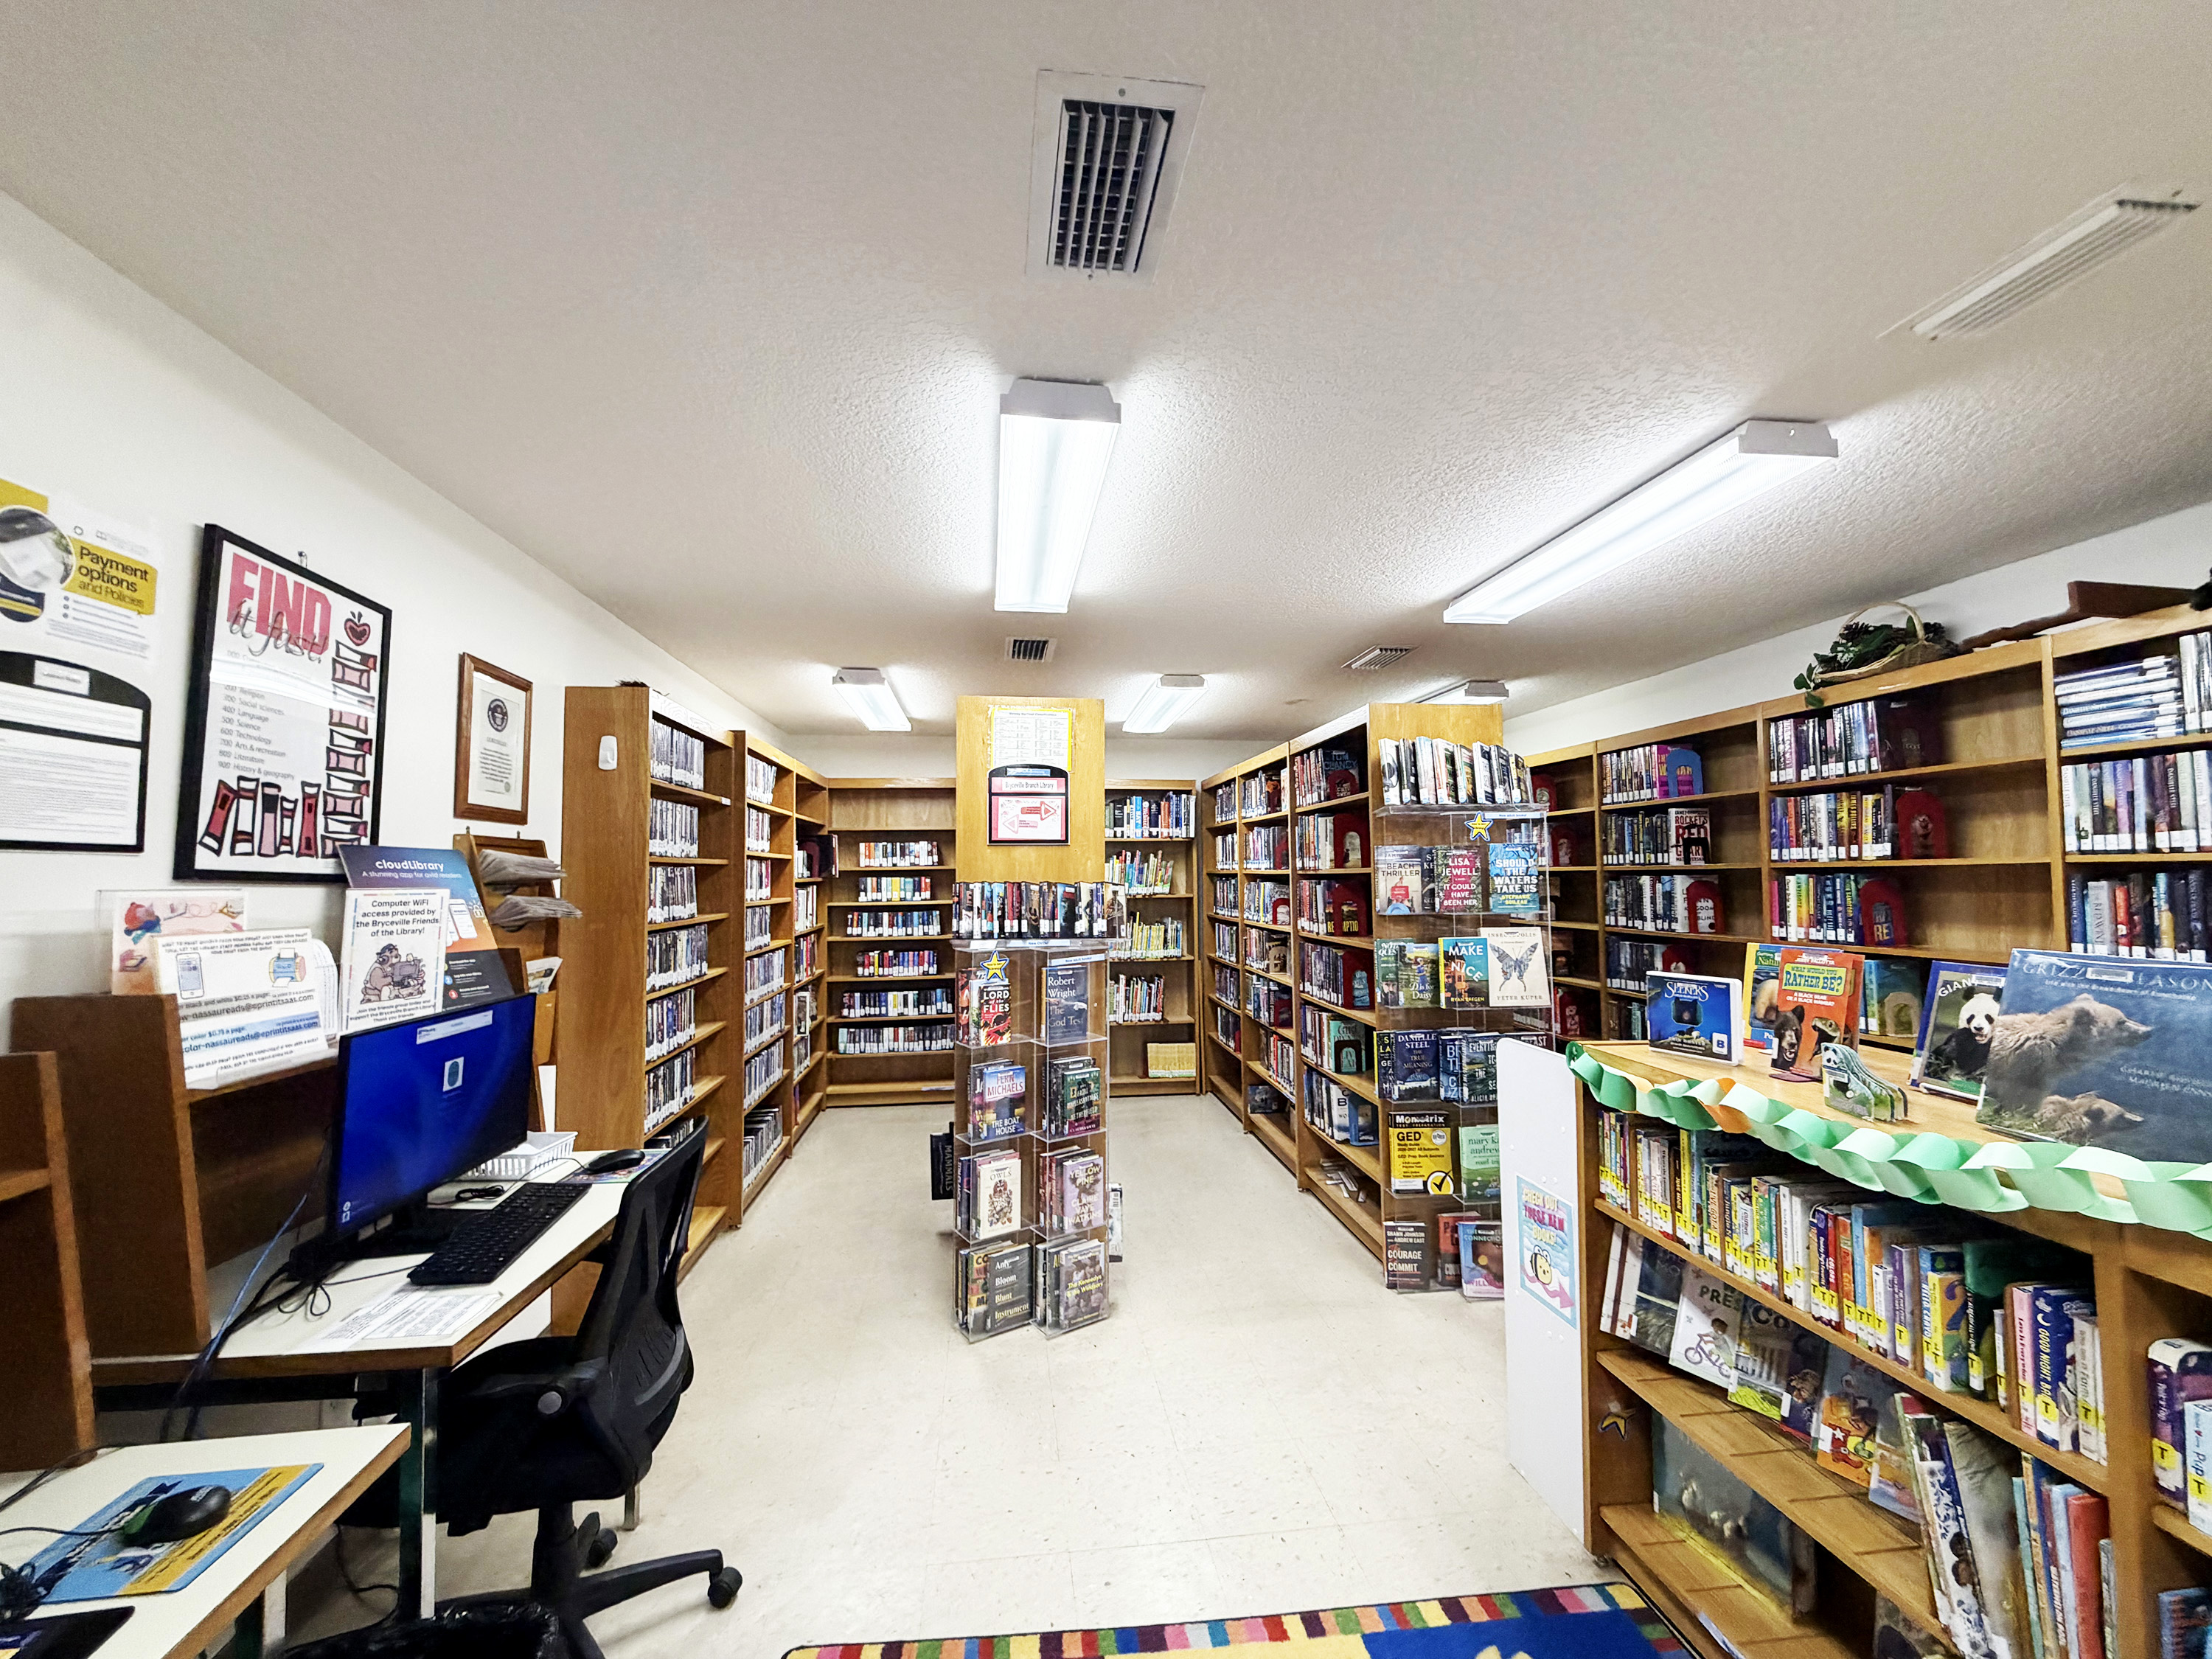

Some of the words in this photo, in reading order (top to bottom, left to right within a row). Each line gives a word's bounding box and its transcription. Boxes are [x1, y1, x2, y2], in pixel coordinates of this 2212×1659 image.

[80, 546, 149, 582] Payment
[77, 565, 139, 594] options
[78, 580, 103, 595] and
[104, 588, 145, 609] Policies
[227, 552, 332, 655] FIND
[229, 599, 257, 639] it
[236, 718, 261, 731] Science
[235, 730, 271, 745] Technology
[1324, 760, 1357, 770] CLANCY
[1005, 781, 1025, 789] Bryceville
[1026, 781, 1040, 789] Branch
[1040, 781, 1054, 790] Library
[1674, 815, 1708, 824] ROCKET'S
[375, 859, 444, 872] cloudLibrary
[1449, 858, 1470, 866] LISA
[1495, 858, 1534, 868] SHOULD
[1441, 867, 1478, 876] JEWELL
[1504, 867, 1526, 876] THE
[1493, 875, 1538, 885] WATERS
[1496, 885, 1522, 894] TAKE
[1523, 885, 1537, 893] US
[372, 900, 411, 908] Computer
[392, 909, 426, 919] provided
[427, 908, 437, 917] by
[372, 918, 410, 929] Bryceville
[411, 917, 439, 925] Friends
[370, 929, 380, 937] of
[396, 928, 425, 936] Library!
[1448, 945, 1484, 956] MAKE
[1450, 961, 1484, 982] NICE
[1048, 977, 1075, 987] Robert
[1784, 970, 1821, 989] RATHER
[1822, 975, 1843, 992] BE?
[984, 990, 1010, 1000] LORD
[1048, 989, 1077, 998] Wright
[1412, 990, 1433, 1001] Daisy
[1813, 998, 1835, 1006] MAMBA?
[984, 1004, 1010, 1013] FLIES
[1049, 1005, 1065, 1015] The
[1048, 1017, 1066, 1028] God
[1717, 1040, 1725, 1048] B
[1475, 1068, 1486, 1078] THE
[996, 1074, 1016, 1085] FERN
[987, 1081, 1024, 1097] MICHAELS
[992, 1119, 1004, 1129] THE
[1004, 1116, 1020, 1127] BOAT
[995, 1124, 1016, 1135] HOUSE
[1397, 1131, 1422, 1141] GED
[945, 1144, 953, 1192] MAMMALS
[1069, 1165, 1102, 1178] YELLOW
[990, 1170, 1012, 1180] OWLS
[1076, 1175, 1095, 1186] PINE
[1523, 1188, 1544, 1206] CHECK
[1545, 1194, 1559, 1210] OUT
[1638, 1189, 1644, 1198] T
[1071, 1192, 1099, 1208] CLAIRE
[1076, 1203, 1095, 1214] VAYE
[1069, 1210, 1103, 1225] WATKINS
[1524, 1204, 1546, 1225] THESE
[1548, 1212, 1565, 1232] NEW
[1532, 1225, 1557, 1245] BOOKS!
[1818, 1237, 1826, 1253] Daddy
[1387, 1249, 1422, 1259] COURAGE
[1743, 1254, 1749, 1265] T
[1388, 1262, 1418, 1272] COMMIT
[995, 1273, 1017, 1287] Bloom
[1078, 1274, 1102, 1287] Kennedys
[1811, 1284, 1818, 1295] T
[995, 1292, 1012, 1304] Blunt
[995, 1303, 1029, 1320] Instrument
[1844, 1303, 1852, 1315] T
[2037, 1328, 2051, 1356] GOOD
[2042, 1399, 2051, 1415] T
[2157, 1445, 2168, 1460] T
[2192, 1450, 2206, 1477] Pup
[2192, 1478, 2205, 1495] T
